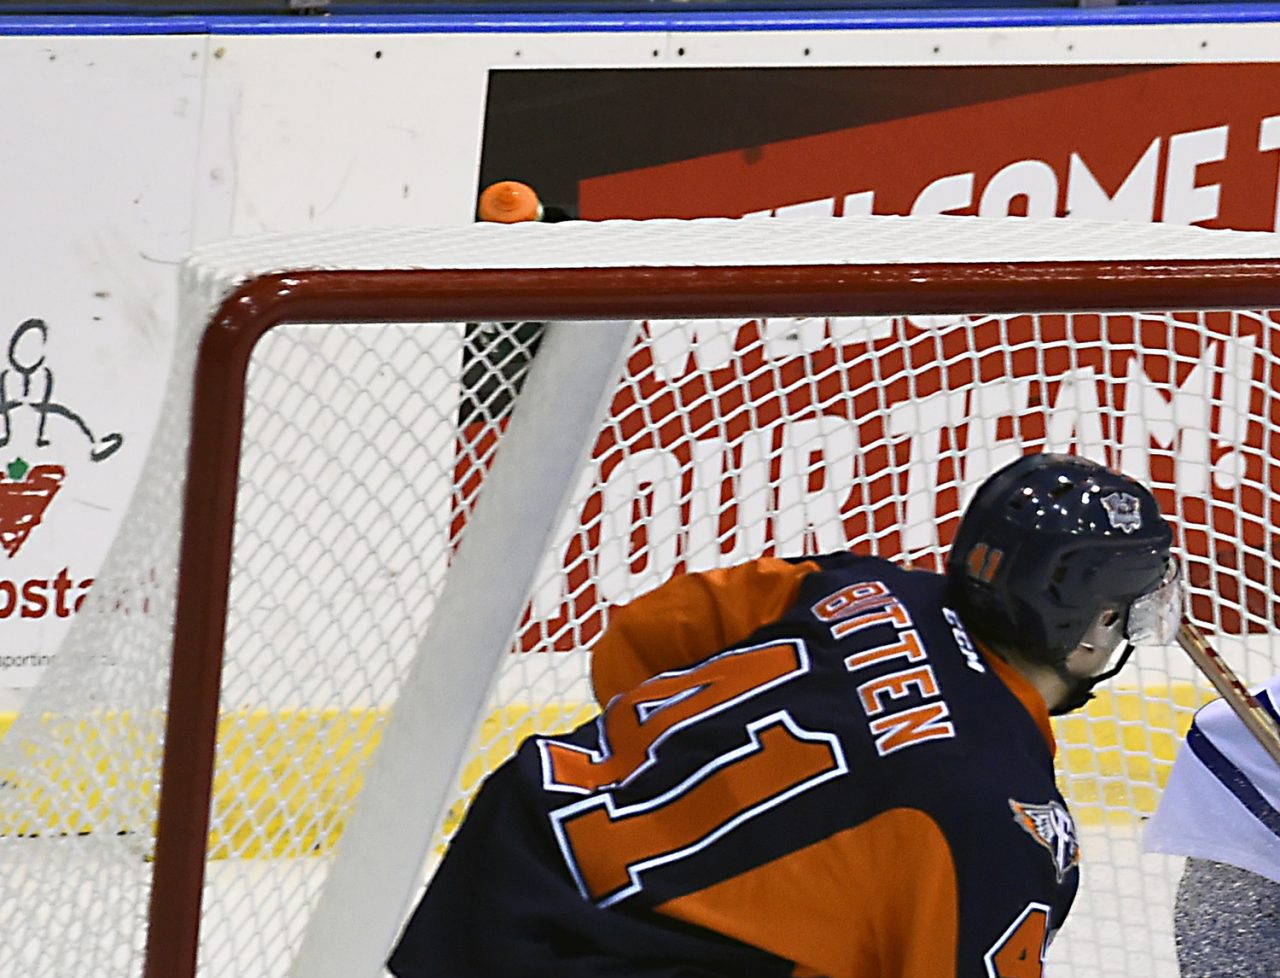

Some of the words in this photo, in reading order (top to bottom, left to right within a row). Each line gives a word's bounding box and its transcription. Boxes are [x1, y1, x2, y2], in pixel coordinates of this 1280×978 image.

[964, 542, 1003, 584] 41
[809, 580, 957, 757] BITTEN
[536, 637, 850, 909] 41
